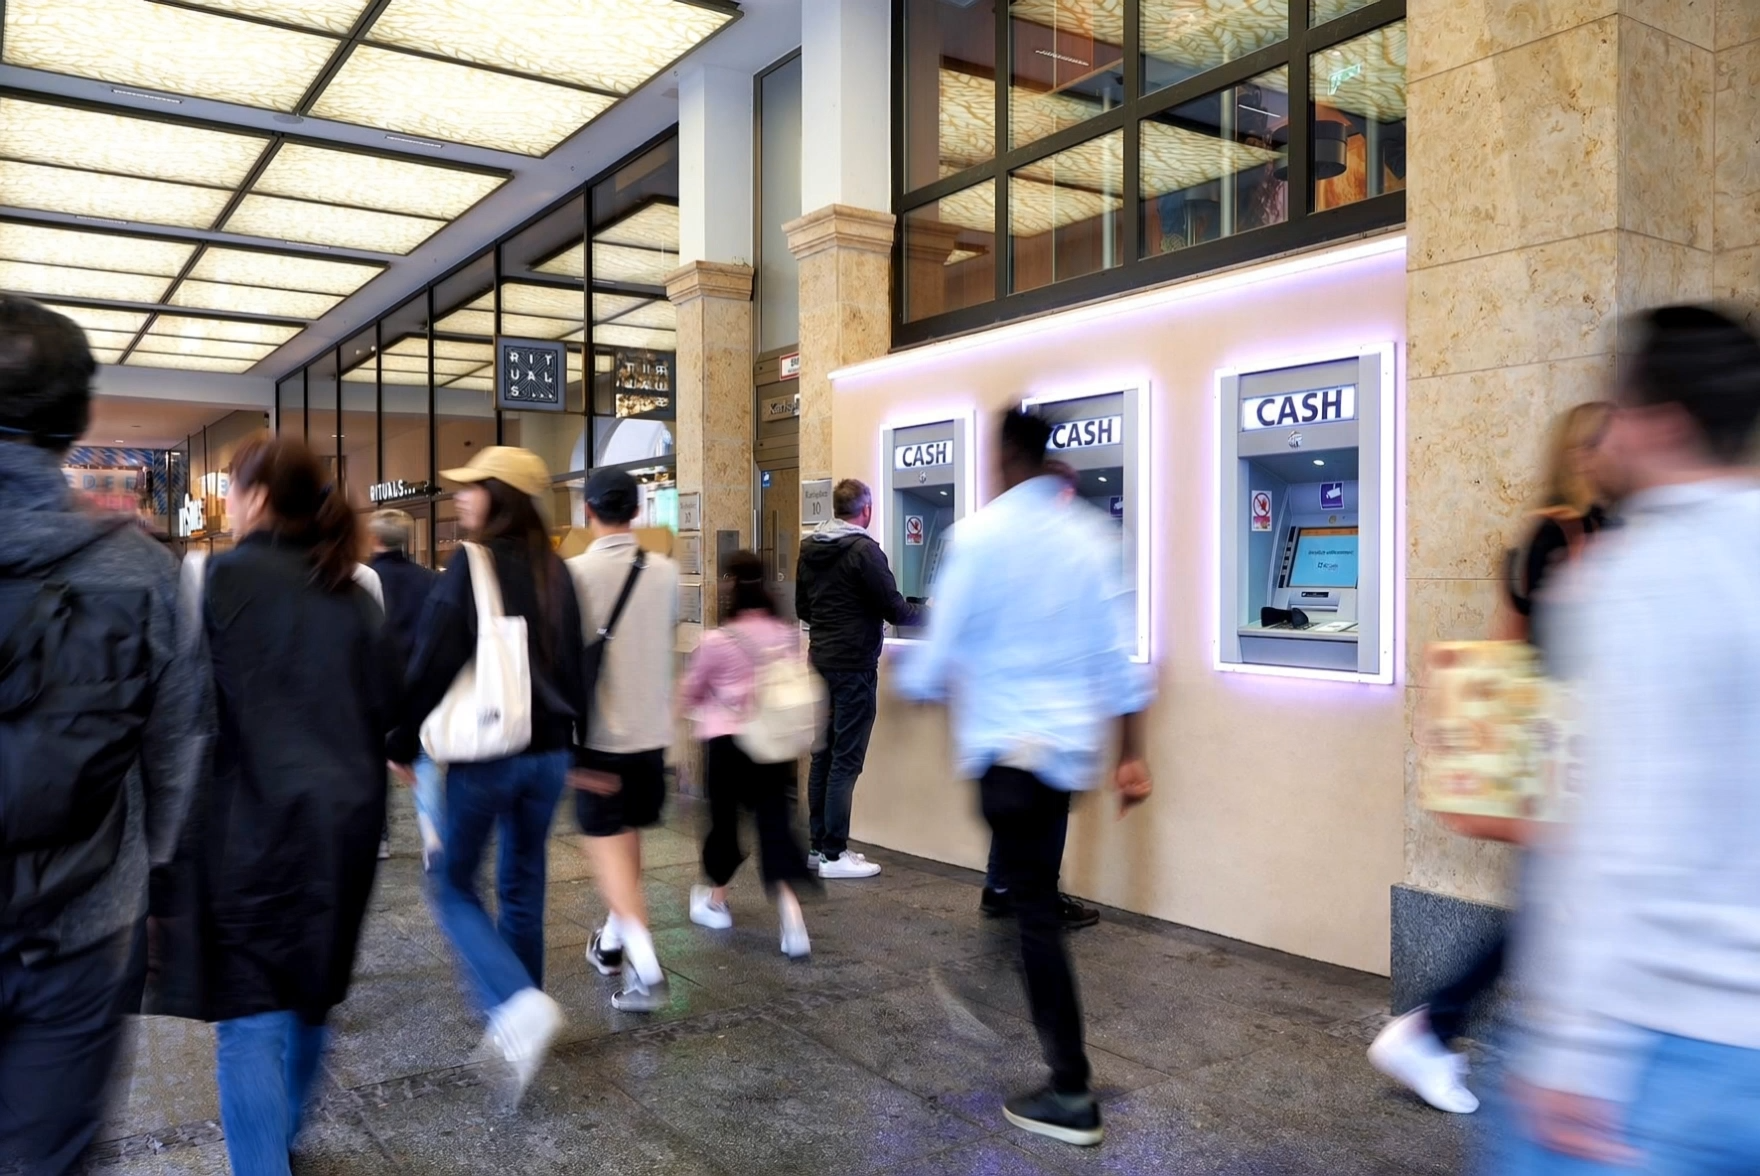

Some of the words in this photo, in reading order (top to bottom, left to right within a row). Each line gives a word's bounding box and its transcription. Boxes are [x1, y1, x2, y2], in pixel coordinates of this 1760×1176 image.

[1256, 389, 1342, 426] CASH
[1052, 418, 1112, 448] CASH
[902, 442, 946, 467] CASH
[812, 501, 821, 515] 10
